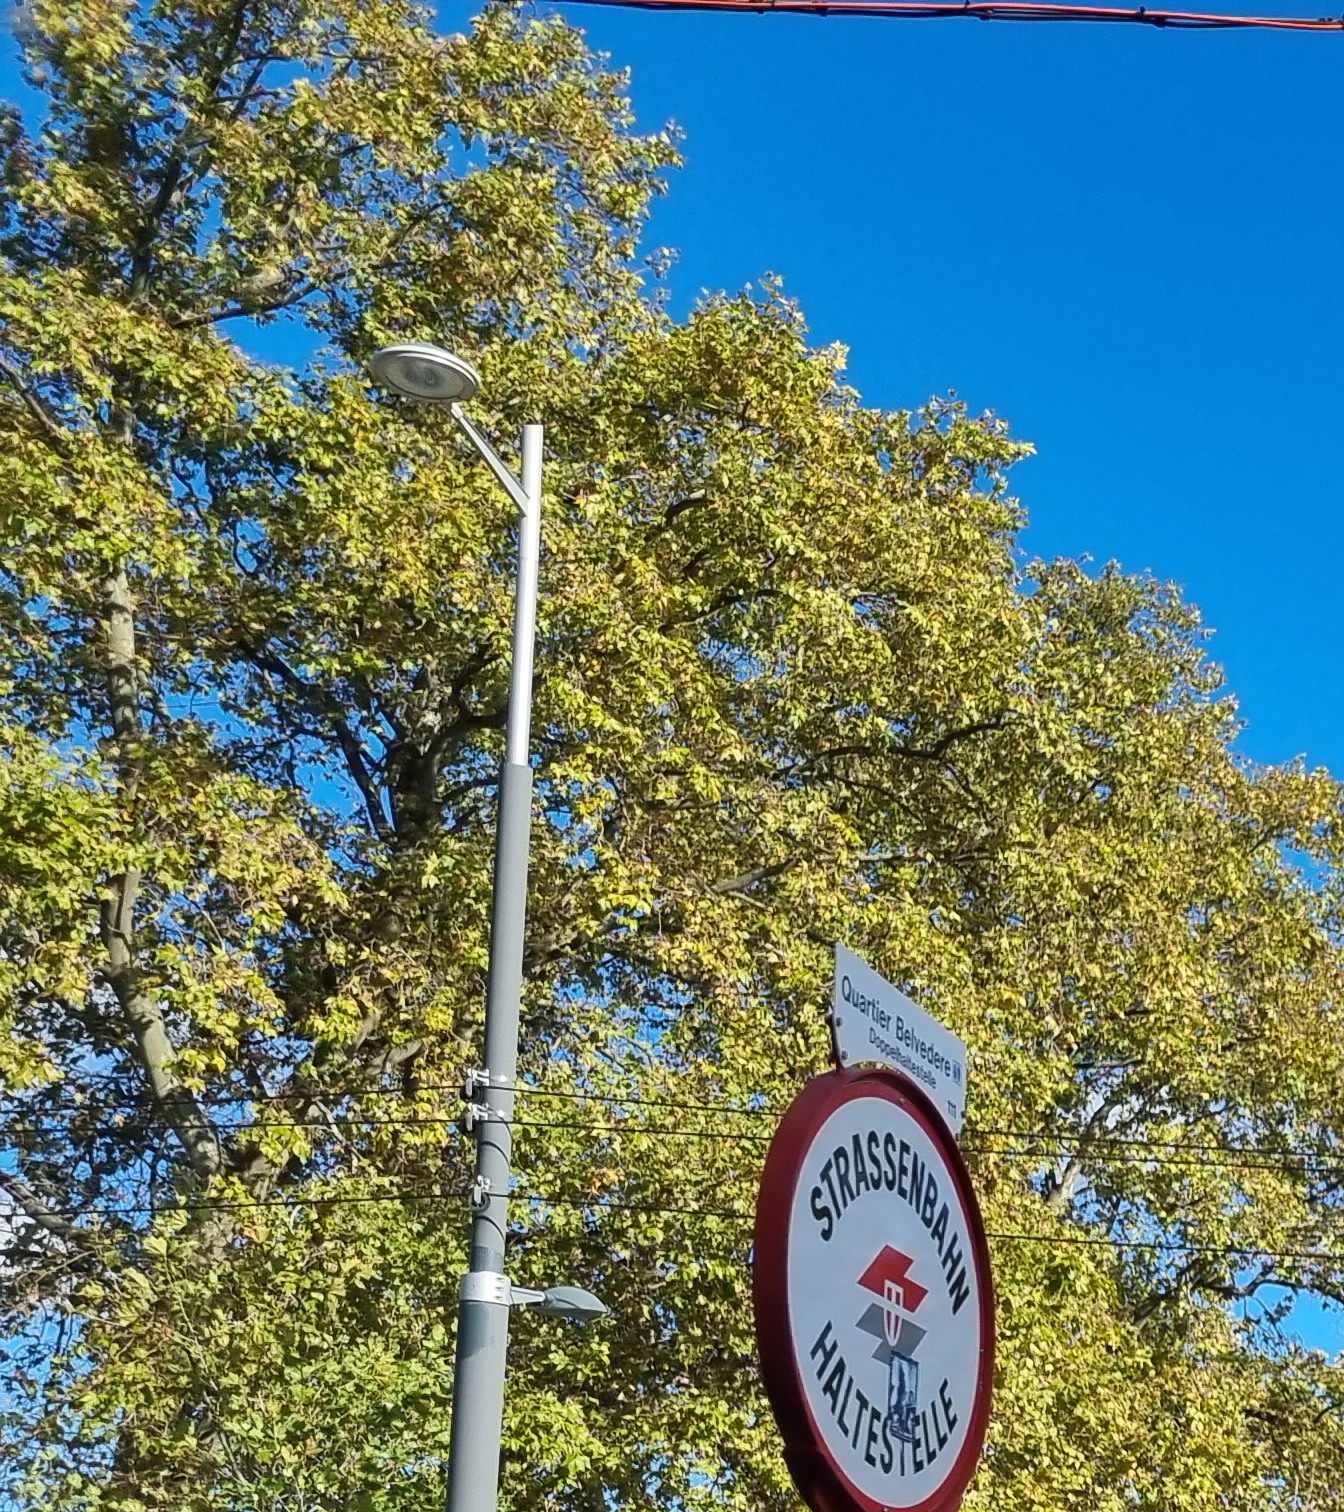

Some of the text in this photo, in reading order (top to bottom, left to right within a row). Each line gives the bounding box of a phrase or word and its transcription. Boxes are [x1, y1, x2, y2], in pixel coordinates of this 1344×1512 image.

[841, 975, 951, 1078] Quartier Belvedere
[868, 1026, 938, 1090] Doppelhaltestelle
[809, 1131, 971, 1316] STRASSENBAHN
